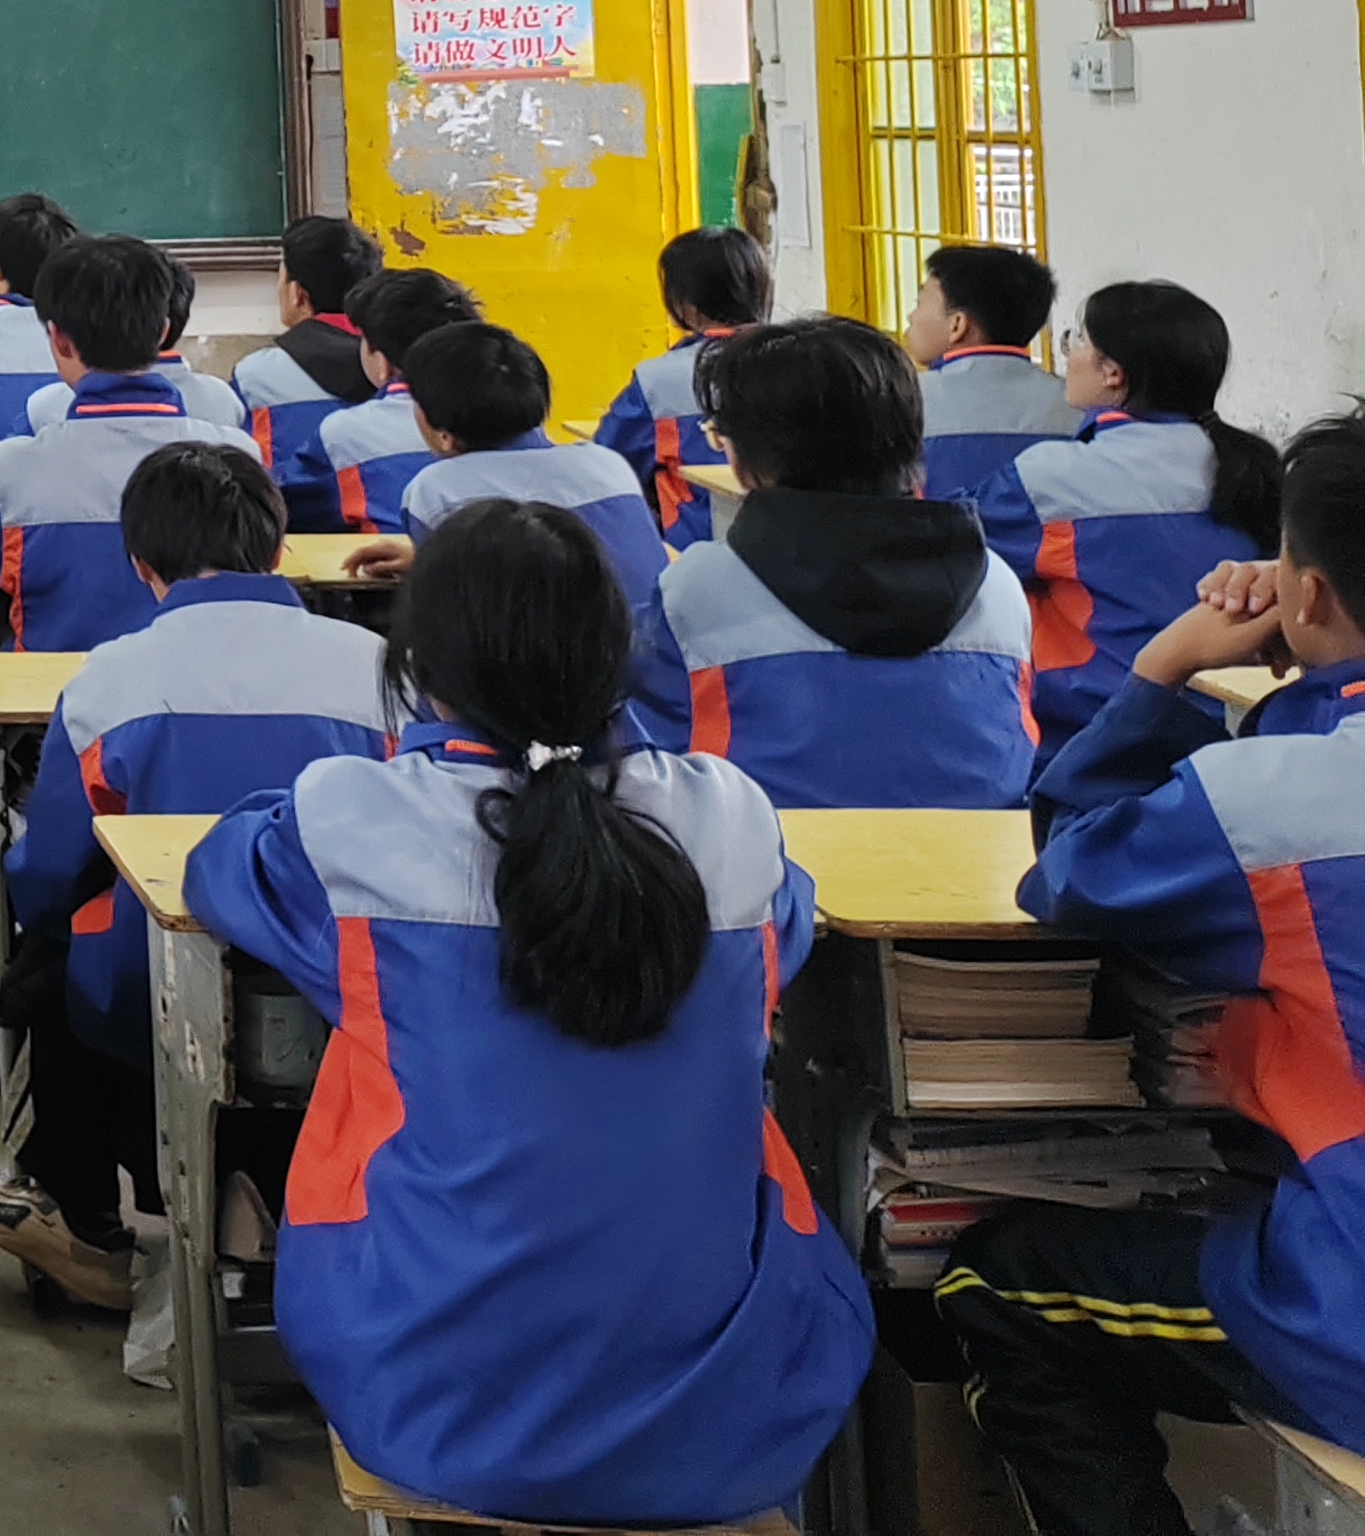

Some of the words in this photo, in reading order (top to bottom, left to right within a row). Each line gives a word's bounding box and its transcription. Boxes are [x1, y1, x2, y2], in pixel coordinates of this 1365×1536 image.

[412, 4, 575, 34] 请写规范字
[414, 35, 577, 66] 请做文明人
